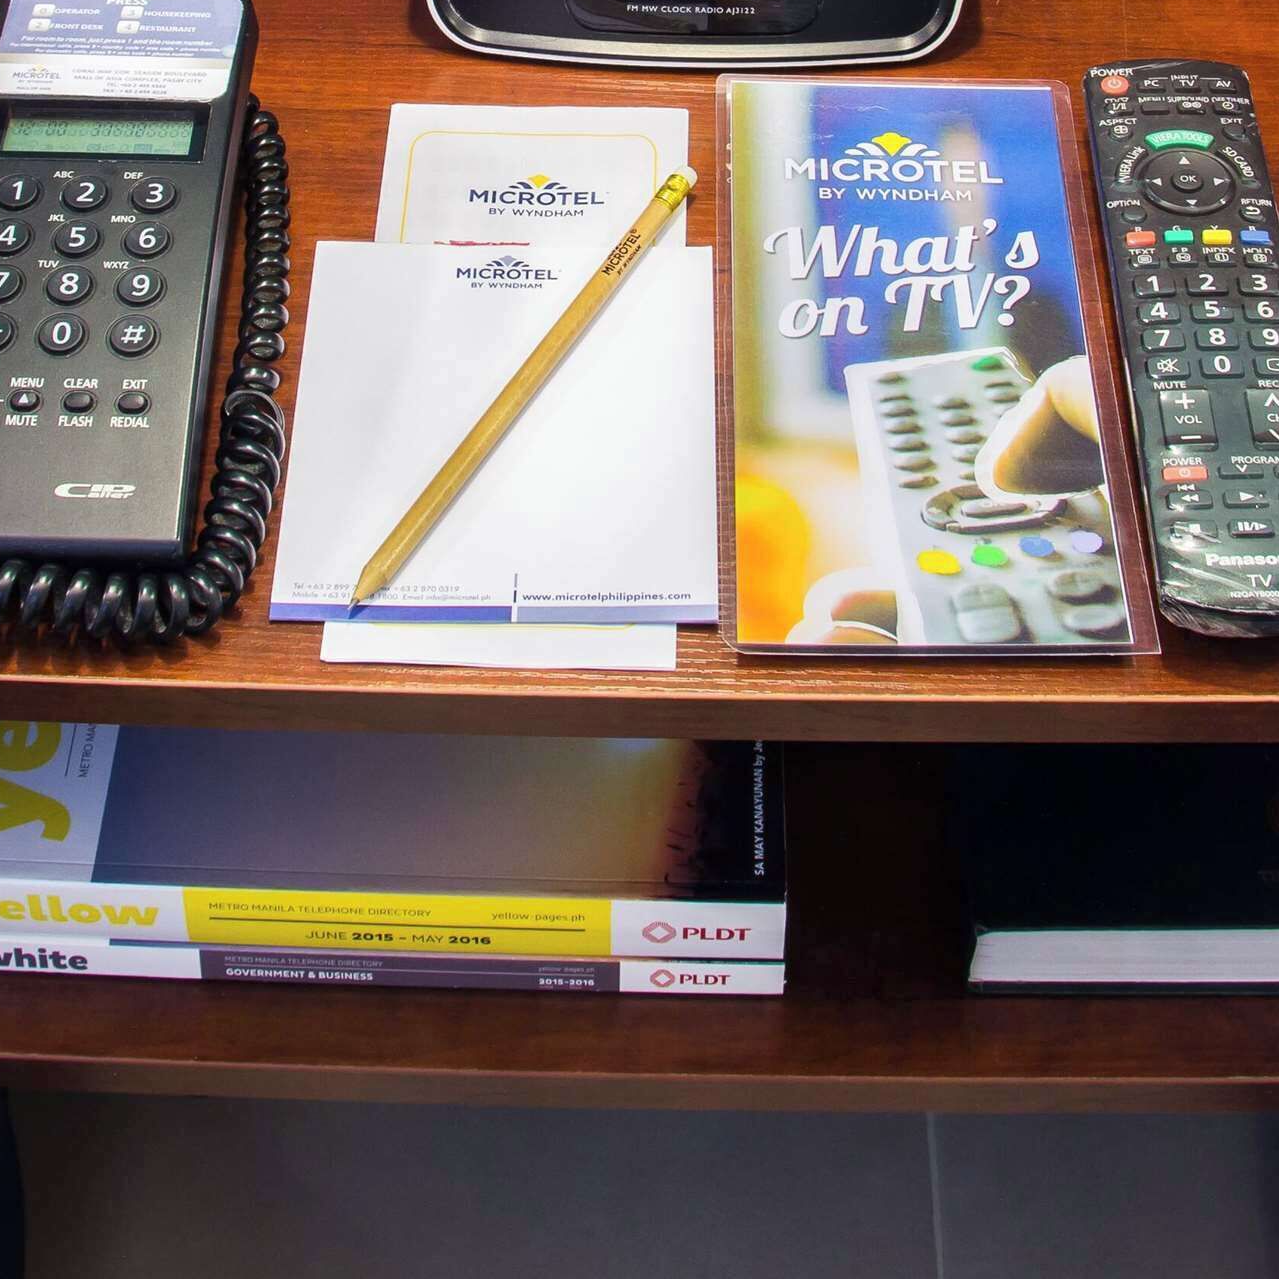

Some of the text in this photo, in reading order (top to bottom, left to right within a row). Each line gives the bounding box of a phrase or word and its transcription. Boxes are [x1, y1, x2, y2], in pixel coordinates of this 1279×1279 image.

[54, 8, 101, 16] OPERATOR
[144, 10, 211, 18] HOUSEKEEPING
[661, 5, 692, 14] CLOCK
[695, 6, 723, 14] RADIO
[726, 6, 755, 15] AJ3122
[13, 72, 61, 80] MICROTEL
[1091, 68, 1134, 78] POWER
[1099, 118, 1137, 126] ASPECT
[1130, 146, 1146, 160] Link
[1222, 146, 1255, 177] SD CARD
[53, 171, 74, 179] ABC
[784, 158, 1003, 184] MICROTEL
[1180, 175, 1198, 183] OK
[12, 181, 163, 203] 1 2 3
[469, 189, 605, 205] MICROTEL
[819, 187, 972, 201] BY WYNDHAM
[1107, 198, 1272, 209] OPTION RETURN
[48, 214, 65, 222] JKL
[111, 215, 135, 223] MNO
[512, 209, 584, 217] WYNDHAM
[68, 227, 86, 247] 5
[138, 228, 156, 248] 6
[601, 234, 641, 276] MICROTEL
[763, 218, 1039, 280] What's
[38, 260, 60, 268] TUV
[103, 261, 129, 269] WXYZ
[456, 267, 558, 280] MICROTEL
[59, 273, 79, 294] 8
[131, 274, 151, 296] 9
[1147, 274, 1268, 291] 1 2 3
[778, 272, 1031, 338] on TV?
[1150, 301, 1274, 319] 4 5 6
[52, 322, 70, 344] 0
[1154, 328, 1279, 346] 7 8 9
[1214, 355, 1231, 373] 0
[10, 377, 44, 388] MENU
[63, 378, 98, 389] CLEAR
[123, 379, 148, 389] EXIT
[1153, 381, 1187, 390] MUTE
[5, 415, 38, 426] MUTE
[58, 416, 94, 427] FLASH
[110, 417, 150, 428] REDIAL
[1175, 416, 1202, 424] VOL
[1163, 457, 1203, 466] POWER
[1246, 574, 1272, 587] TV
[522, 592, 691, 603] www.microtelphilippines.com
[77, 743, 94, 778] METRO
[753, 754, 766, 876] SA MAY KANAYUNAN by
[209, 902, 432, 918] METRO MANILA TELEPHONE DIRECTORY
[305, 931, 491, 945] JUNE 2015 MAY 2016
[682, 926, 752, 941] PLDT
[288, 957, 337, 966] TELEPHONE
[338, 959, 383, 967] DIRECTORY
[226, 968, 373, 981] GOVERNMENT & BUSINESS
[679, 973, 731, 985] PLDT
[539, 977, 595, 986] 2015-2016
